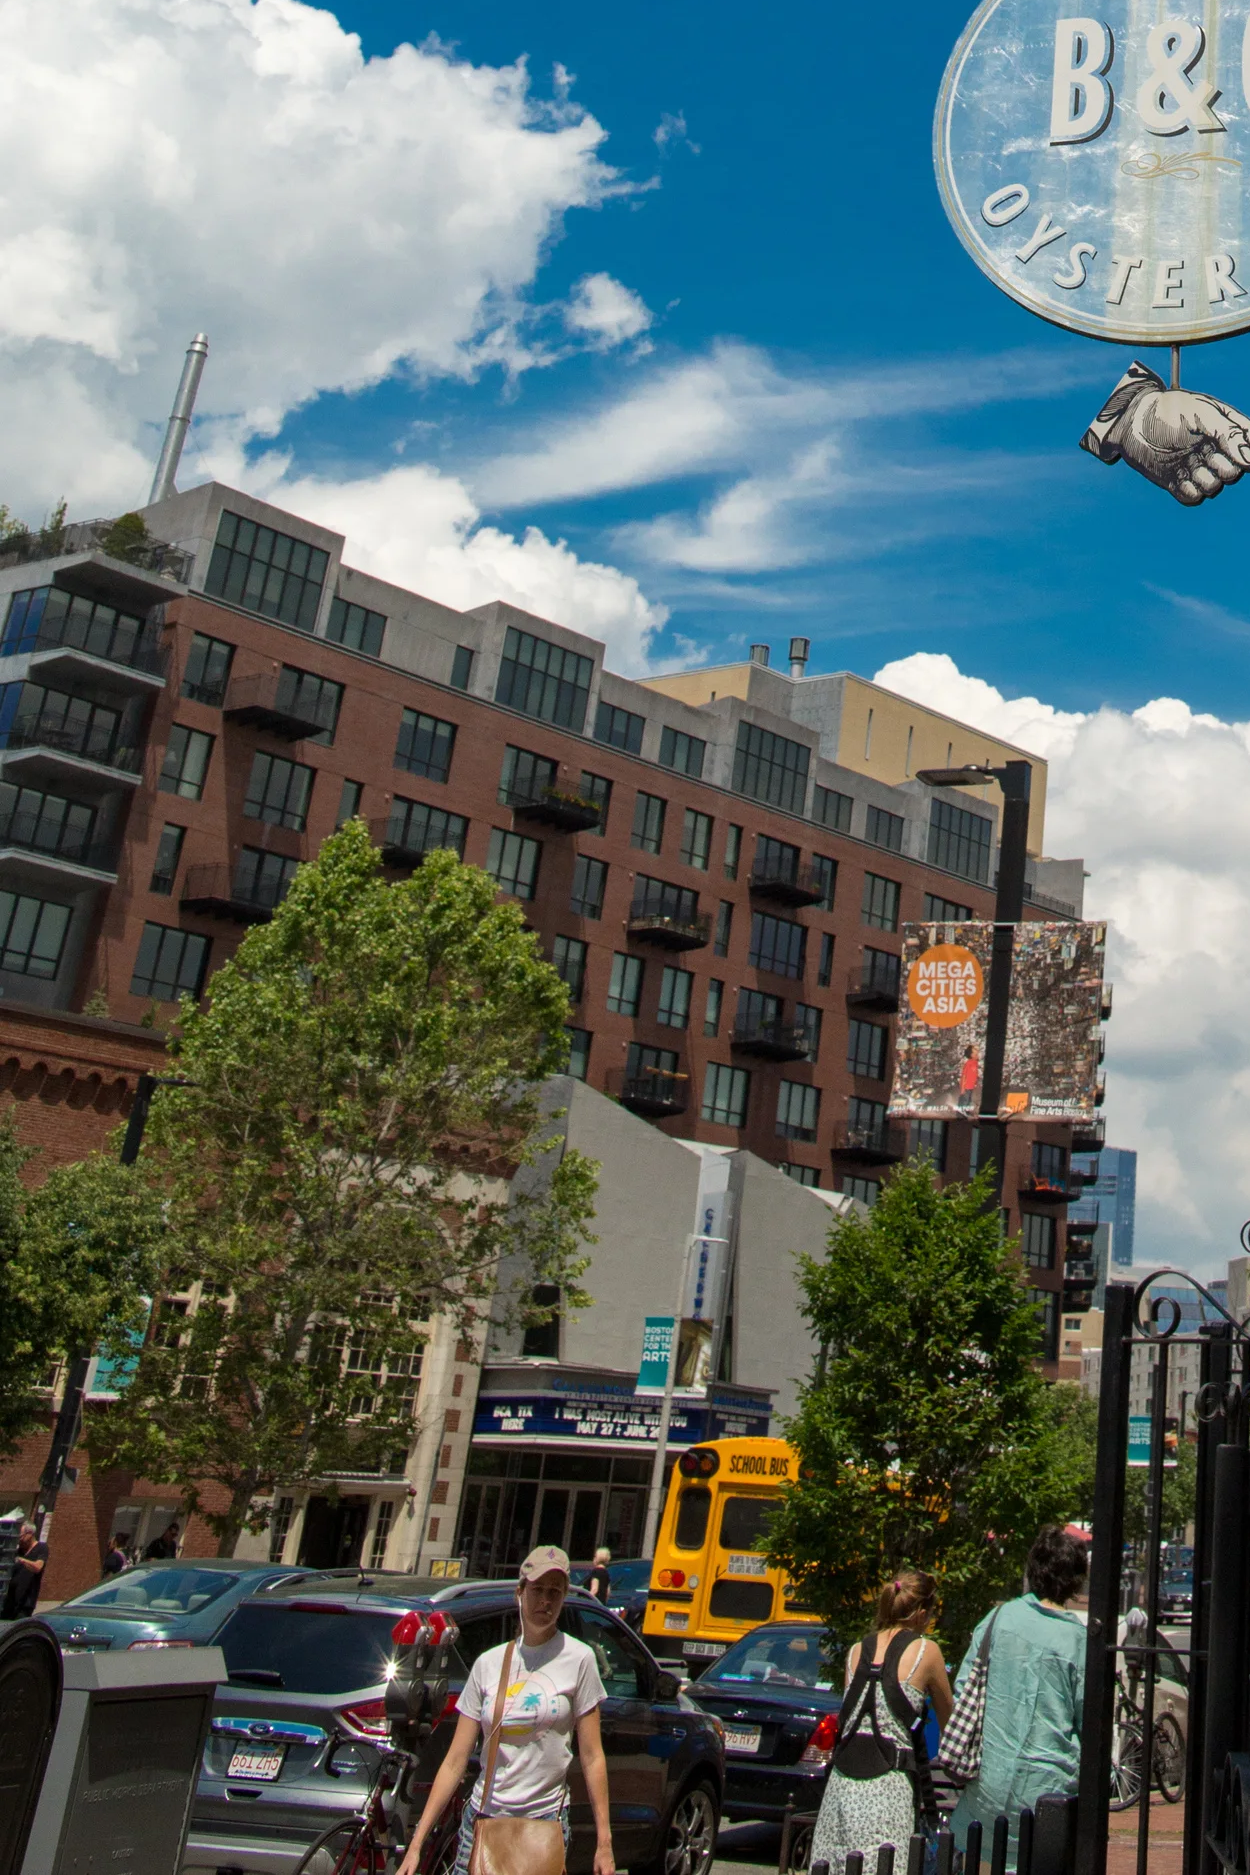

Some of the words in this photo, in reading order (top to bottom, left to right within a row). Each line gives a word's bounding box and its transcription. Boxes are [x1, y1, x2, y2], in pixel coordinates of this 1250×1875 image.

[918, 961, 976, 978] MEGA
[915, 979, 977, 996] CITIES
[922, 996, 968, 1014] ASIA
[1031, 1096, 1064, 1107] Museum
[1030, 1106, 1046, 1115] Fine
[1046, 1107, 1063, 1116] Arts
[643, 1342, 659, 1350] FOR
[563, 1407, 582, 1420] WAS
[586, 1409, 612, 1422] MOST
[612, 1411, 640, 1425] ALIVE
[669, 1415, 688, 1428] YOU
[576, 1421, 596, 1435] MAY
[600, 1423, 614, 1436] 27
[623, 1424, 648, 1438] JUNE
[1128, 1437, 1151, 1445] ARTS
[729, 1455, 767, 1475] SCHOOL
[769, 1457, 789, 1476] BUS
[231, 1749, 253, 1769] 661
[256, 1751, 281, 1771] ZH5
[82, 1788, 111, 1803] PUBLIC
[111, 1785, 136, 1799] WORKS
[139, 1779, 185, 1797] DEPARTMENT
